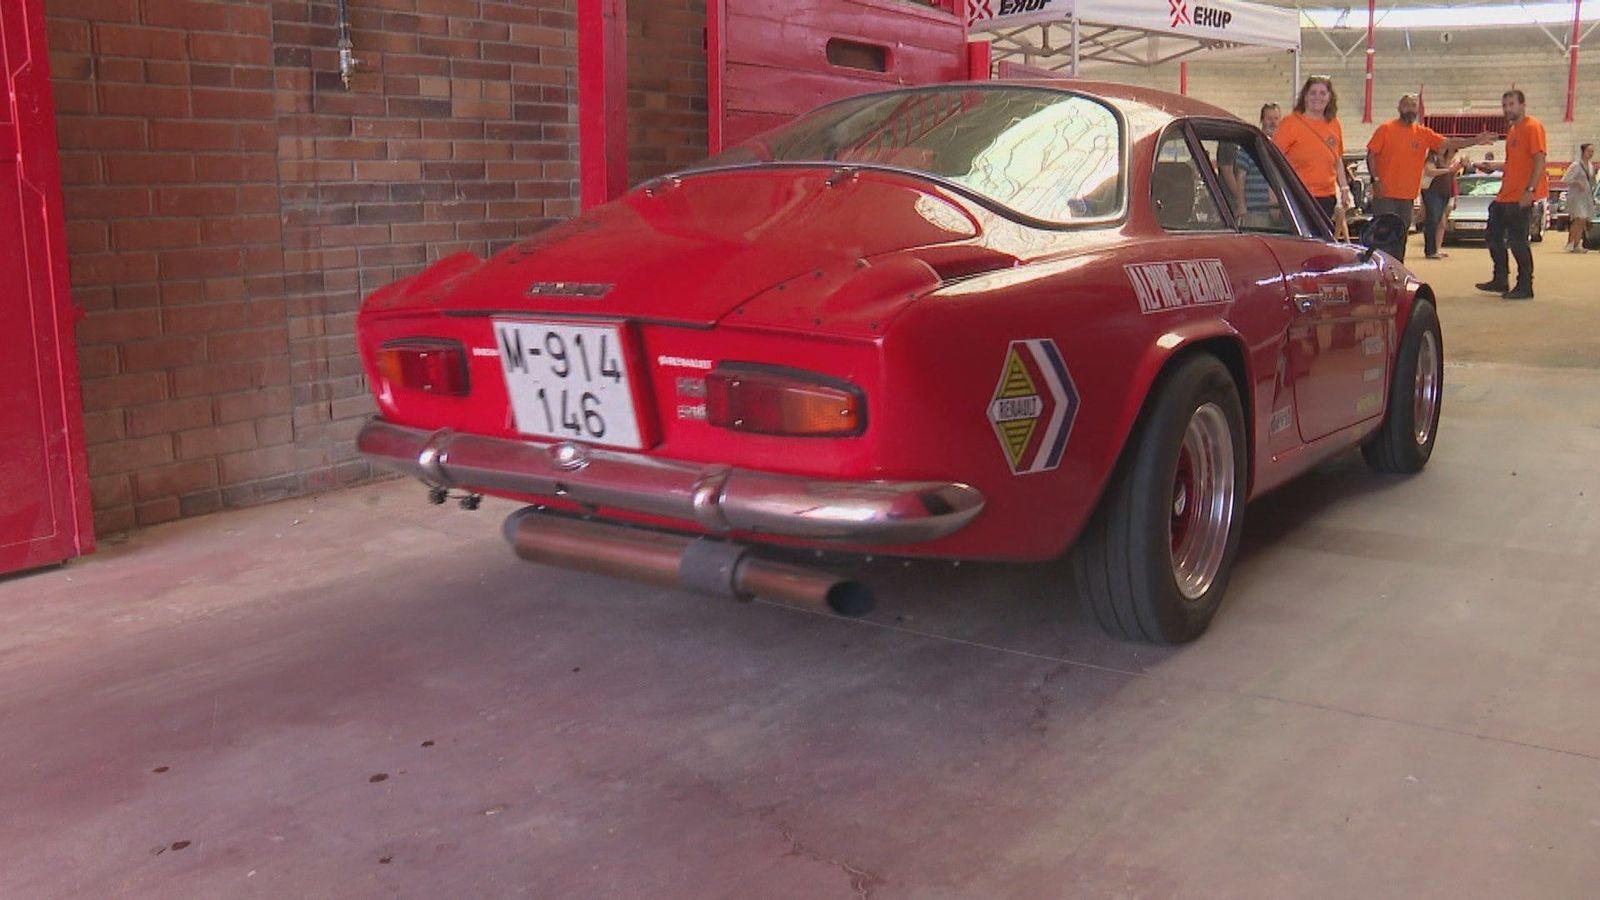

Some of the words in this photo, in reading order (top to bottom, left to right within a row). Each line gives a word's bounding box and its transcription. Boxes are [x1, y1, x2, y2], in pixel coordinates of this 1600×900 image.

[1193, 6, 1232, 29] EXUP
[1125, 263, 1182, 312] ALPINE
[1180, 259, 1233, 304] RENAULT
[500, 327, 621, 384] M-914
[536, 388, 605, 437] 146
[999, 397, 1037, 419] RENAULT
